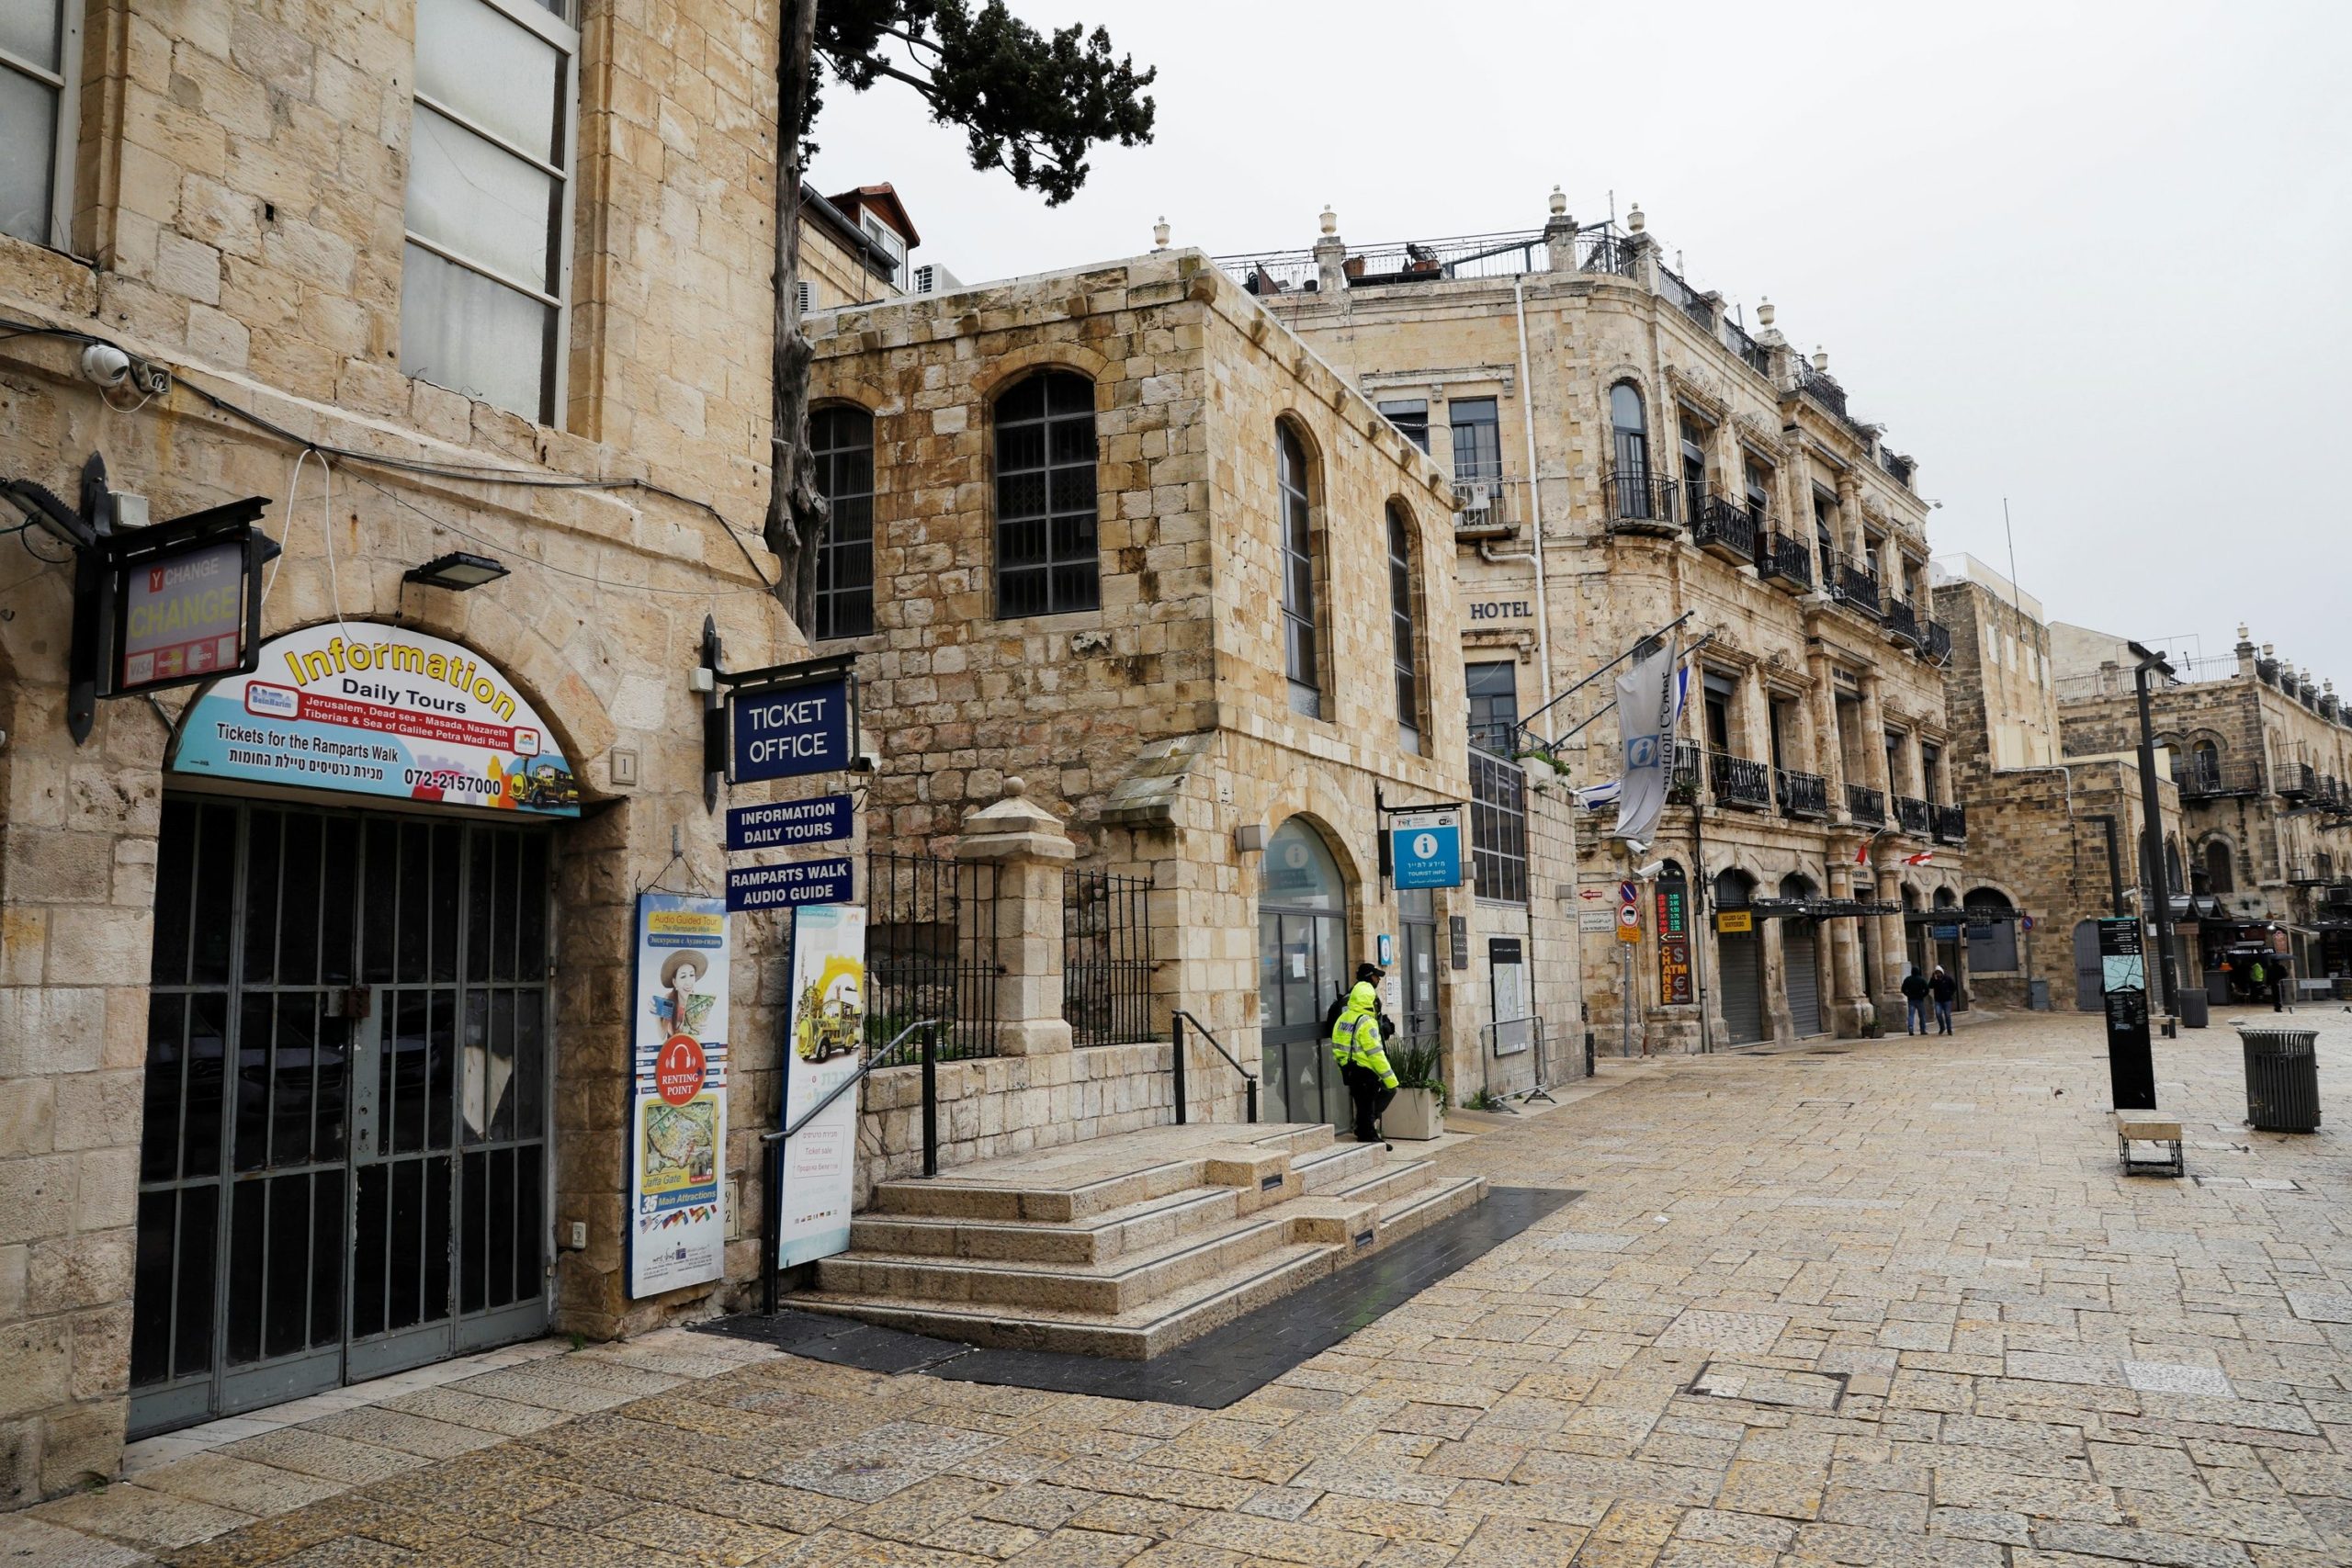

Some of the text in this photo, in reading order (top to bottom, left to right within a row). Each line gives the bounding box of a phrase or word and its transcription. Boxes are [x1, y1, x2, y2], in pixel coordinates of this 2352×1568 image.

[153, 557, 220, 589] Y CHANGE
[130, 585, 237, 638] CHANGE
[1470, 601, 1533, 619] HOTEL
[130, 660, 152, 677] VISA
[284, 637, 516, 722] Information
[343, 678, 467, 714] Daily Tours
[306, 697, 367, 716] Jerusalem,
[369, 706, 396, 719] Dead
[399, 712, 416, 722] sea
[425, 716, 465, 731] Masada,
[467, 723, 508, 738] Nazareth
[749, 698, 827, 730] TICKET
[304, 708, 349, 723] Tiberias
[352, 716, 360, 725] &
[363, 717, 383, 728] Sea
[385, 722, 397, 730] of
[399, 725, 433, 737] Galilee
[436, 729, 460, 741] Petra
[463, 734, 486, 745] Wadi
[488, 739, 509, 749] Rum
[217, 723, 399, 762] Tickets for the Ramparts Walk
[749, 732, 828, 763] OFFICE
[229, 750, 271, 766] החומות
[276, 753, 306, 771] טיילת
[309, 760, 350, 776] כרטיסים
[354, 764, 383, 781] מכירת
[404, 768, 501, 795] 072-2157000
[741, 802, 835, 826] INFORMATION
[744, 822, 832, 843] DAILY TOURS
[731, 863, 847, 887] RAMPARTS WALK
[743, 884, 833, 905] AUDIO GUIDE
[654, 914, 718, 926] Audio Guided Tour
[1661, 946, 1671, 1003] CHANGE
[1662, 964, 1688, 975] ATM
[662, 1072, 698, 1085] RENTING
[667, 1085, 693, 1097] POINT
[821, 1146, 832, 1155] sale
[643, 1174, 682, 1188] Jaffa Gate
[641, 1190, 717, 1213] 35 Main Attractions
